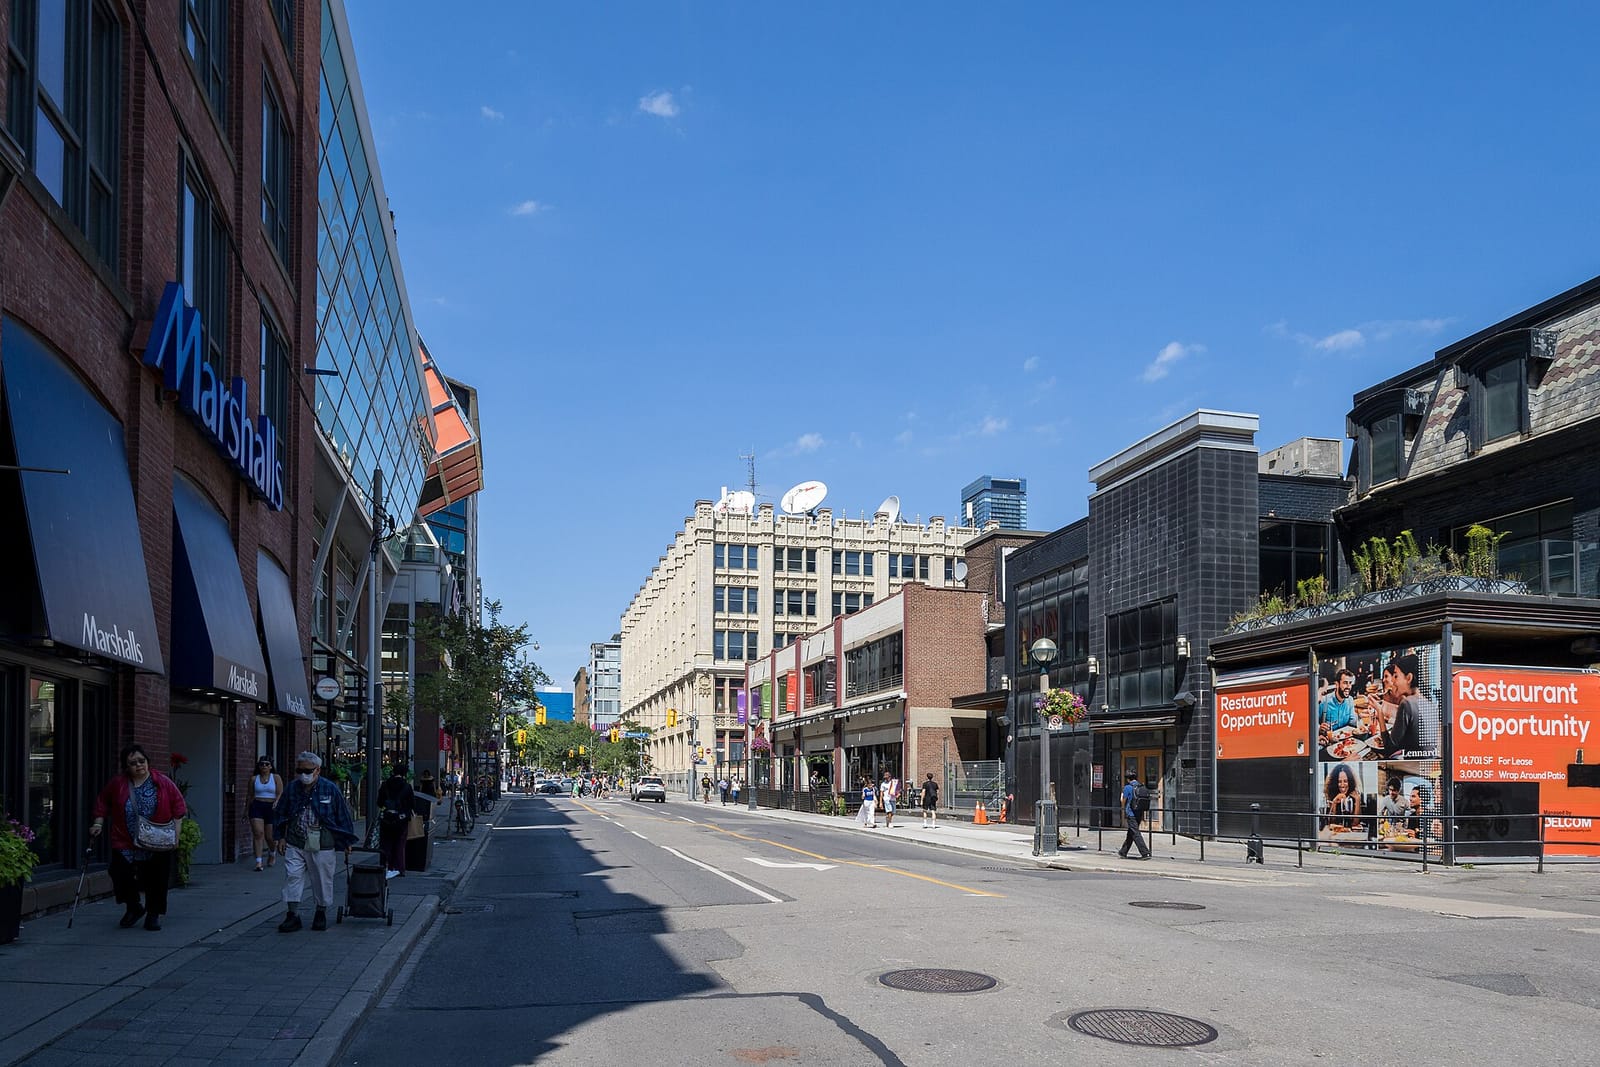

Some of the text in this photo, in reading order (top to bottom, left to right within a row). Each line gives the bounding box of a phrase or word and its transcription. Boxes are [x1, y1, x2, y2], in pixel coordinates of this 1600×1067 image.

[144, 281, 283, 512] Marshalls
[82, 612, 144, 664] Marshalls
[227, 664, 258, 697] Marshalls
[1458, 675, 1579, 704] Restaurant
[1220, 690, 1288, 711] Restaurant
[1220, 708, 1295, 732] Opportunity
[1459, 709, 1590, 743] Opportunity
[1460, 770, 1566, 781] 3,000 SF Wrap Around Patio
[1483, 757, 1494, 765] SF
[1498, 757, 1511, 766] For
[1511, 757, 1533, 766] Lease
